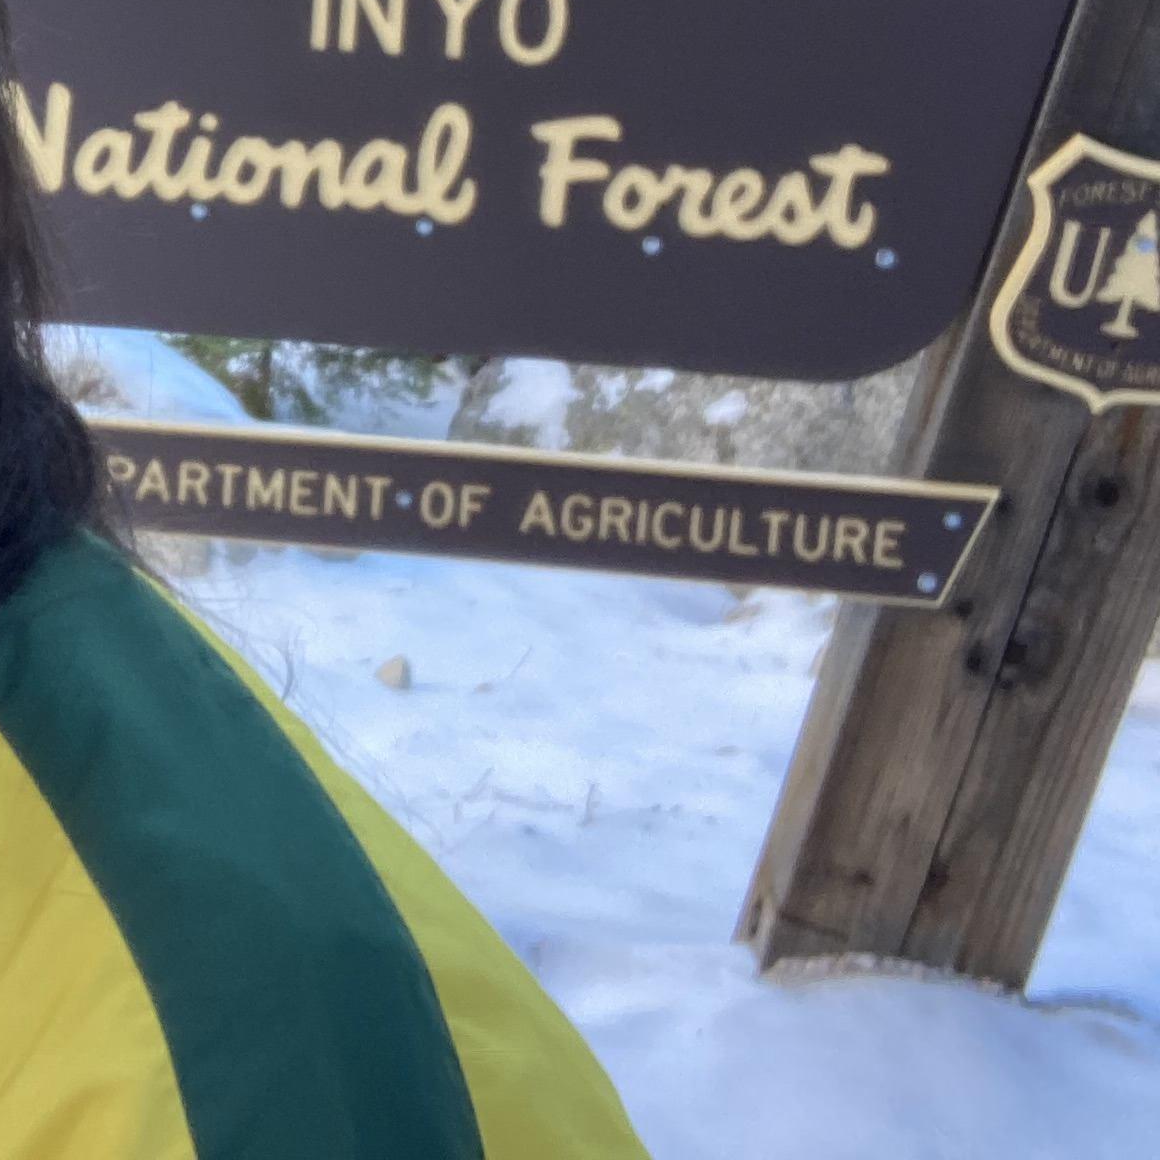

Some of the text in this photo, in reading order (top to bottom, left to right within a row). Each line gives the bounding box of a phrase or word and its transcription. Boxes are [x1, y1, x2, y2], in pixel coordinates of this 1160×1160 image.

[3, 80, 891, 248] National Forest
[106, 454, 907, 568] PARTMENT OF AGRICULTURE
